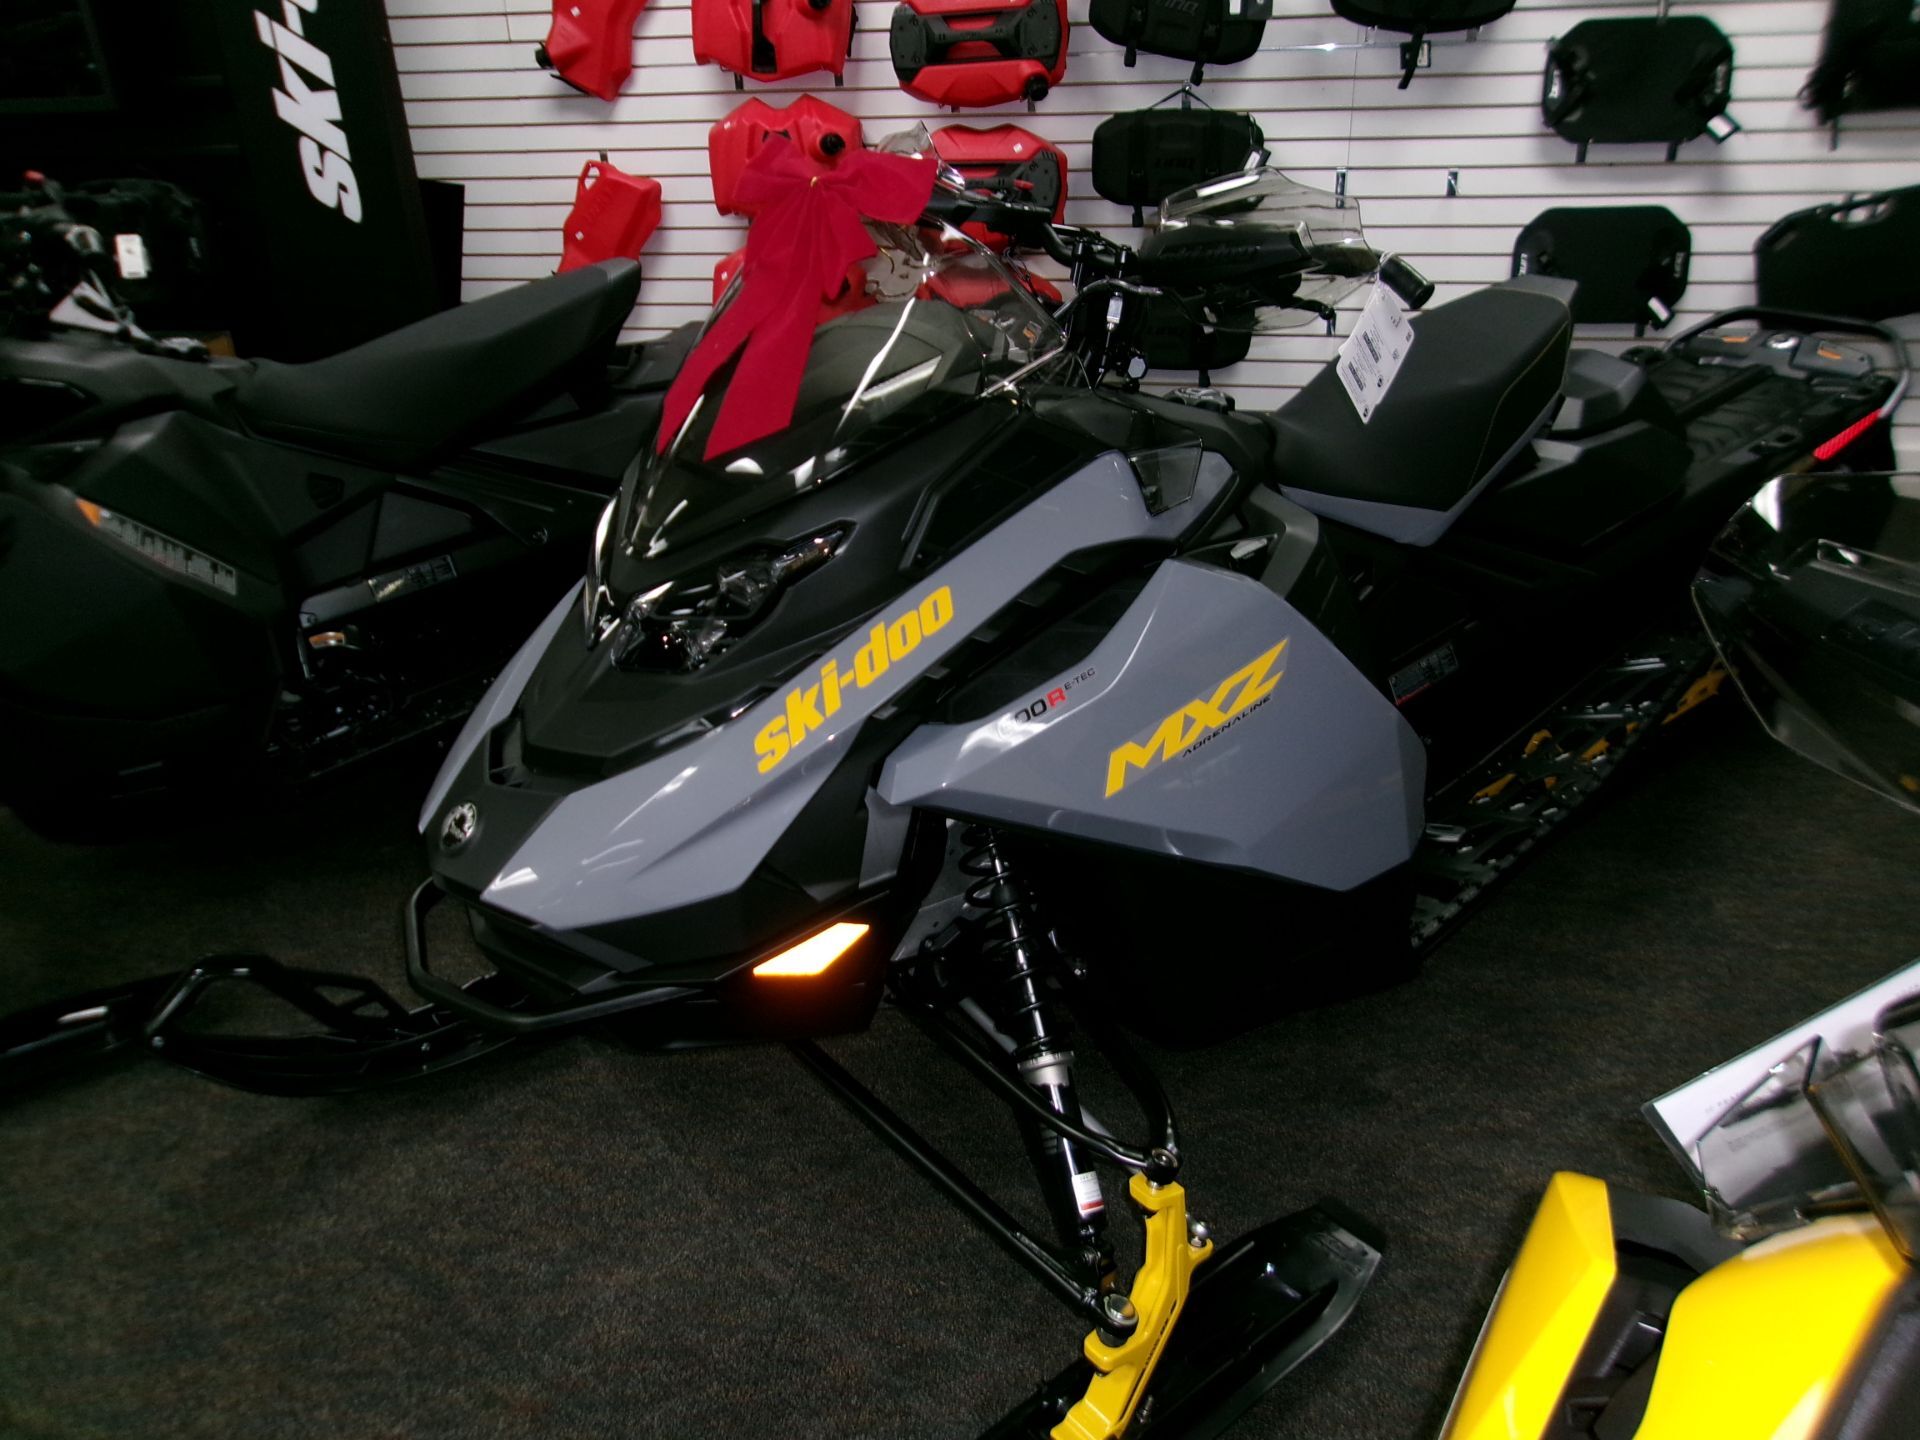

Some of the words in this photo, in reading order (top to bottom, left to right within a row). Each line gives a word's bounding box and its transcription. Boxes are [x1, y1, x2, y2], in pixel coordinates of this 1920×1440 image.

[253, 0, 363, 225] ski-
[754, 585, 954, 774] ski-doo
[996, 687, 1066, 738] 00R
[1064, 667, 1096, 690] E-TEC
[1105, 637, 1291, 799] MXZ
[1182, 694, 1271, 758] ADRENALINE
